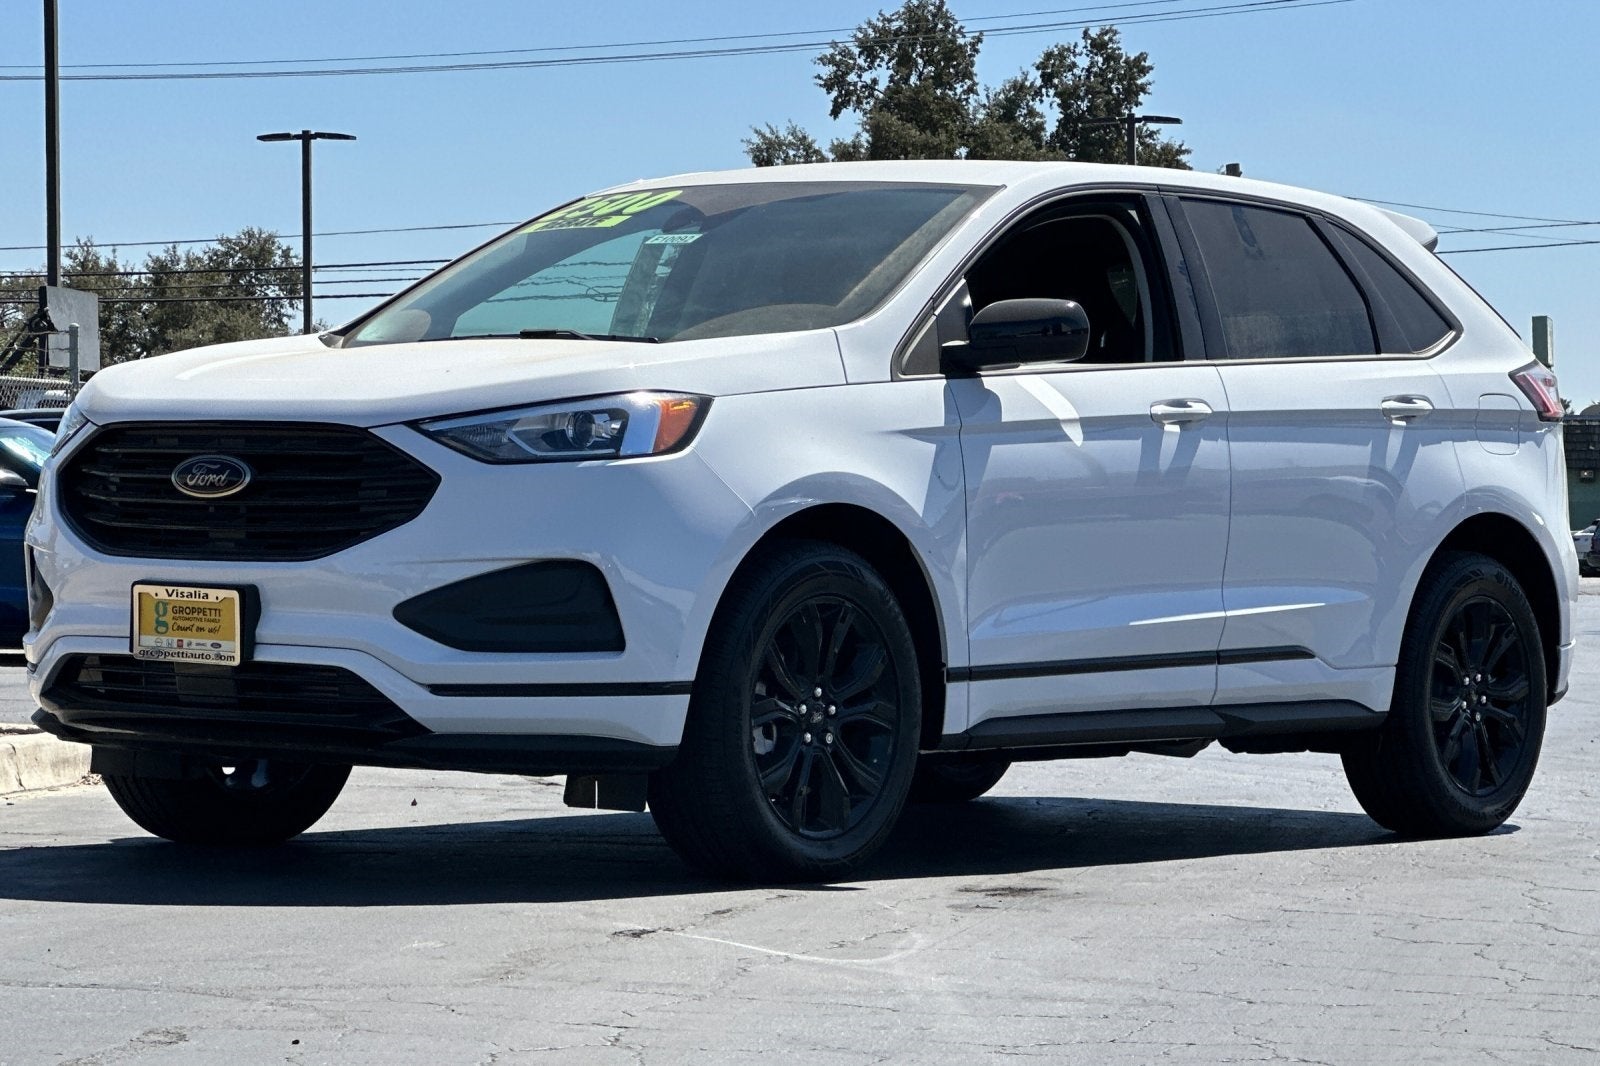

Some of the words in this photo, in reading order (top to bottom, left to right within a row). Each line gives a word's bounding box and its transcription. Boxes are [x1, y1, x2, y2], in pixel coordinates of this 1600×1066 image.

[537, 189, 683, 222] 2500
[186, 462, 230, 486] Ford
[165, 588, 209, 599] Visalia
[171, 606, 221, 617] GROPPETTI
[171, 622, 195, 632] Count
